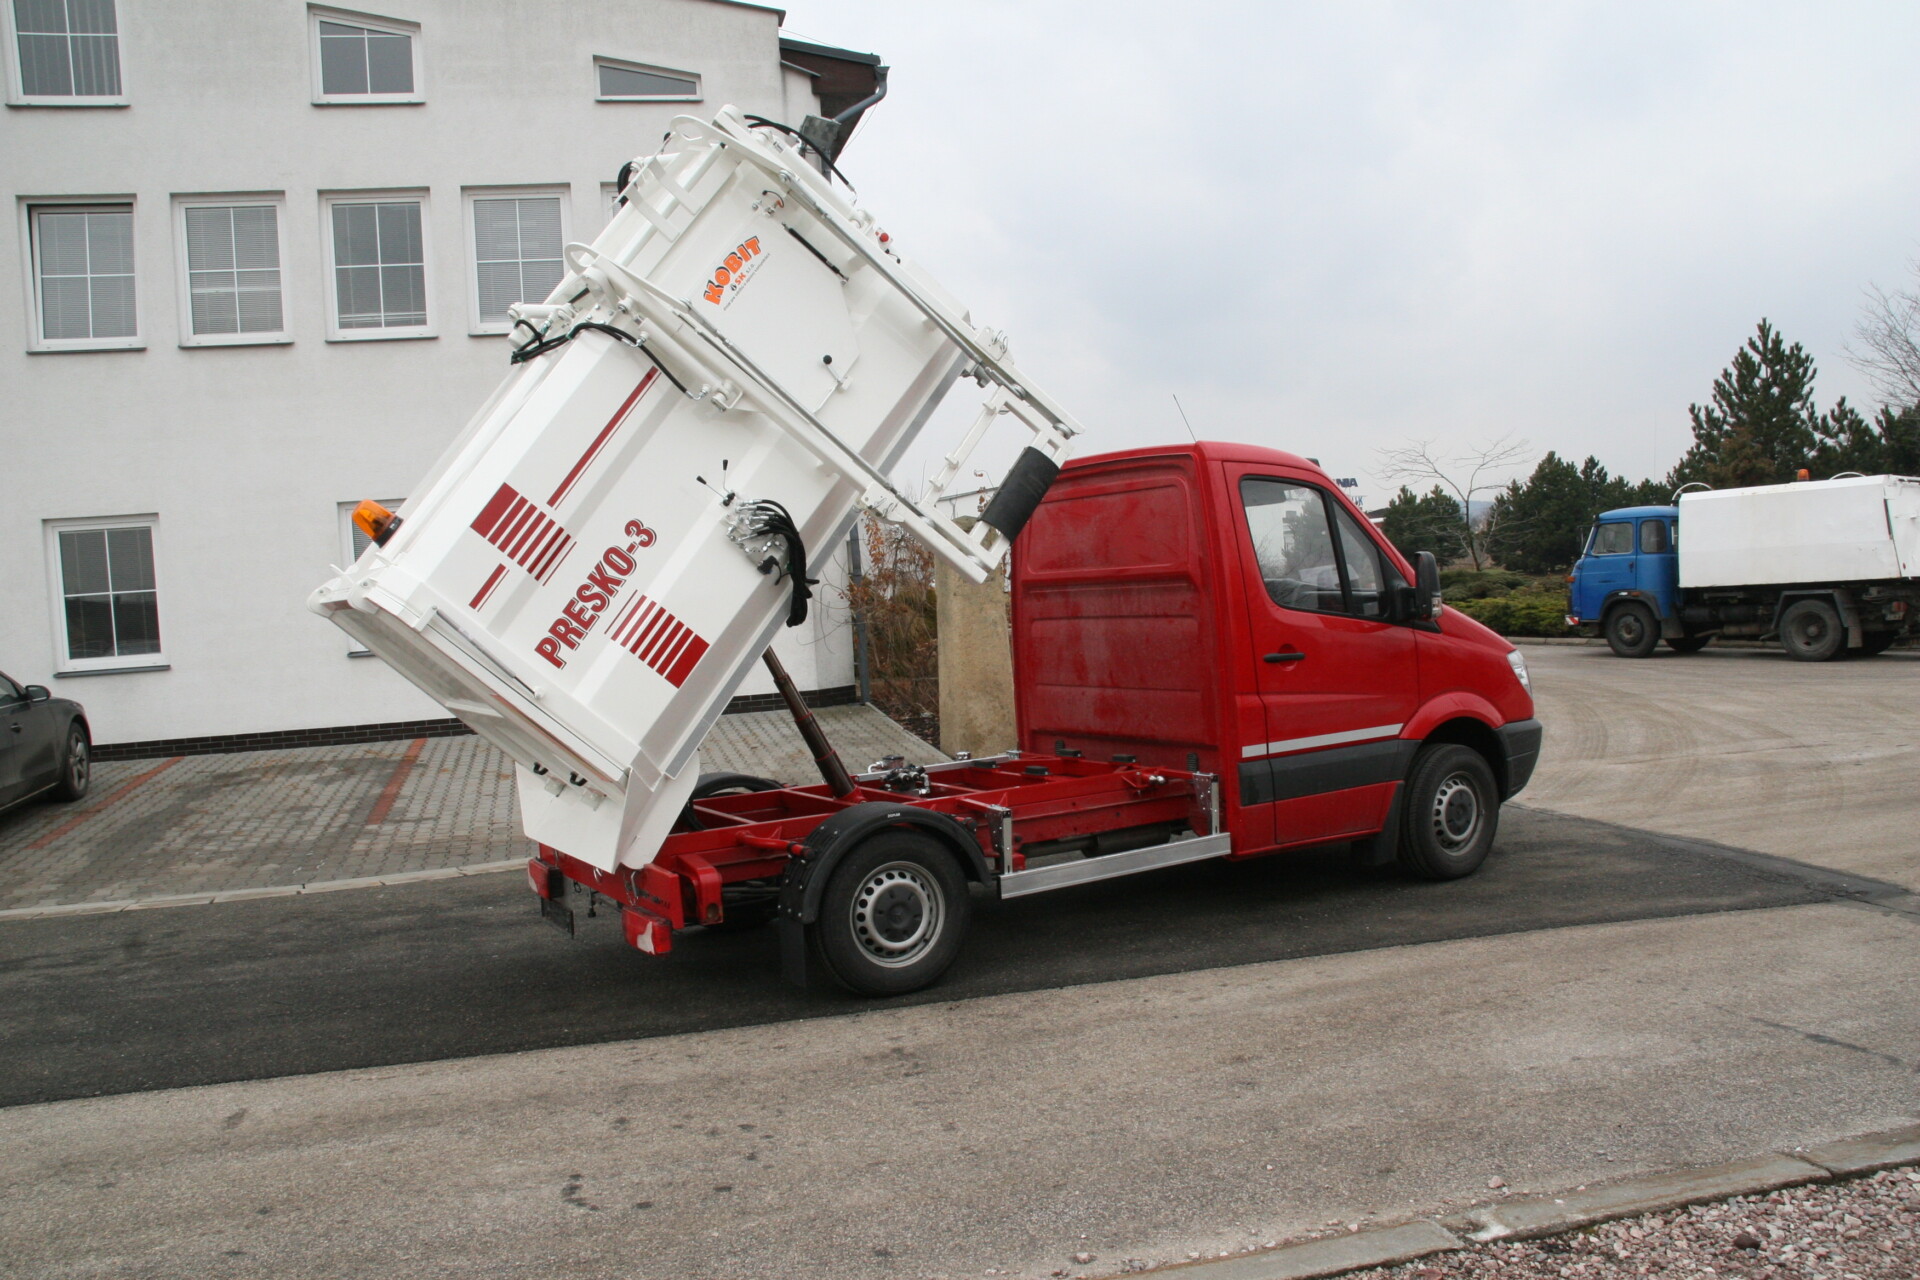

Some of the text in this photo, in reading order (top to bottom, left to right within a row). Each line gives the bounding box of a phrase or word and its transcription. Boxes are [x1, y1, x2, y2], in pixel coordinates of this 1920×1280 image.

[703, 236, 761, 305] KOBIT
[735, 272, 746, 285] SK
[1333, 478, 1358, 487] NIA
[534, 518, 657, 670] PRESKO-3
